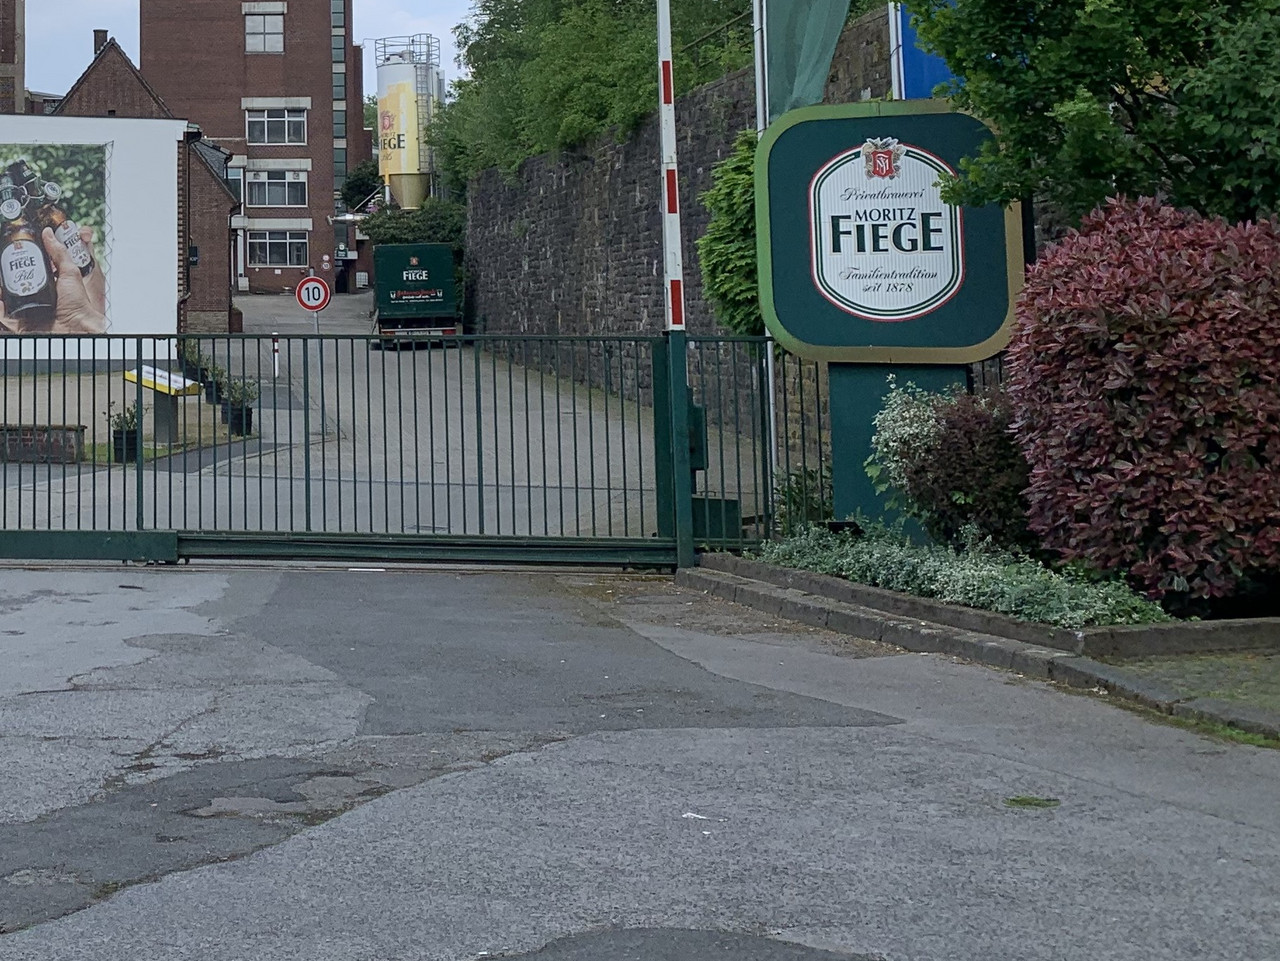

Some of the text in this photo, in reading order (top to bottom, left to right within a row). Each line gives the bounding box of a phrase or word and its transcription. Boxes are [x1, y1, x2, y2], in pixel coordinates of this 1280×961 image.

[380, 133, 406, 151] IEGE
[840, 186, 925, 201] Privatbrauerei
[854, 207, 917, 222] MORITZ
[830, 212, 944, 253] FIEGE
[9, 256, 36, 271] FIEGE
[14, 269, 35, 283] Pils
[402, 270, 429, 281] FIEGE
[839, 266, 938, 280] Familientradition
[305, 286, 321, 302] 10
[862, 282, 914, 293] seit 1878
